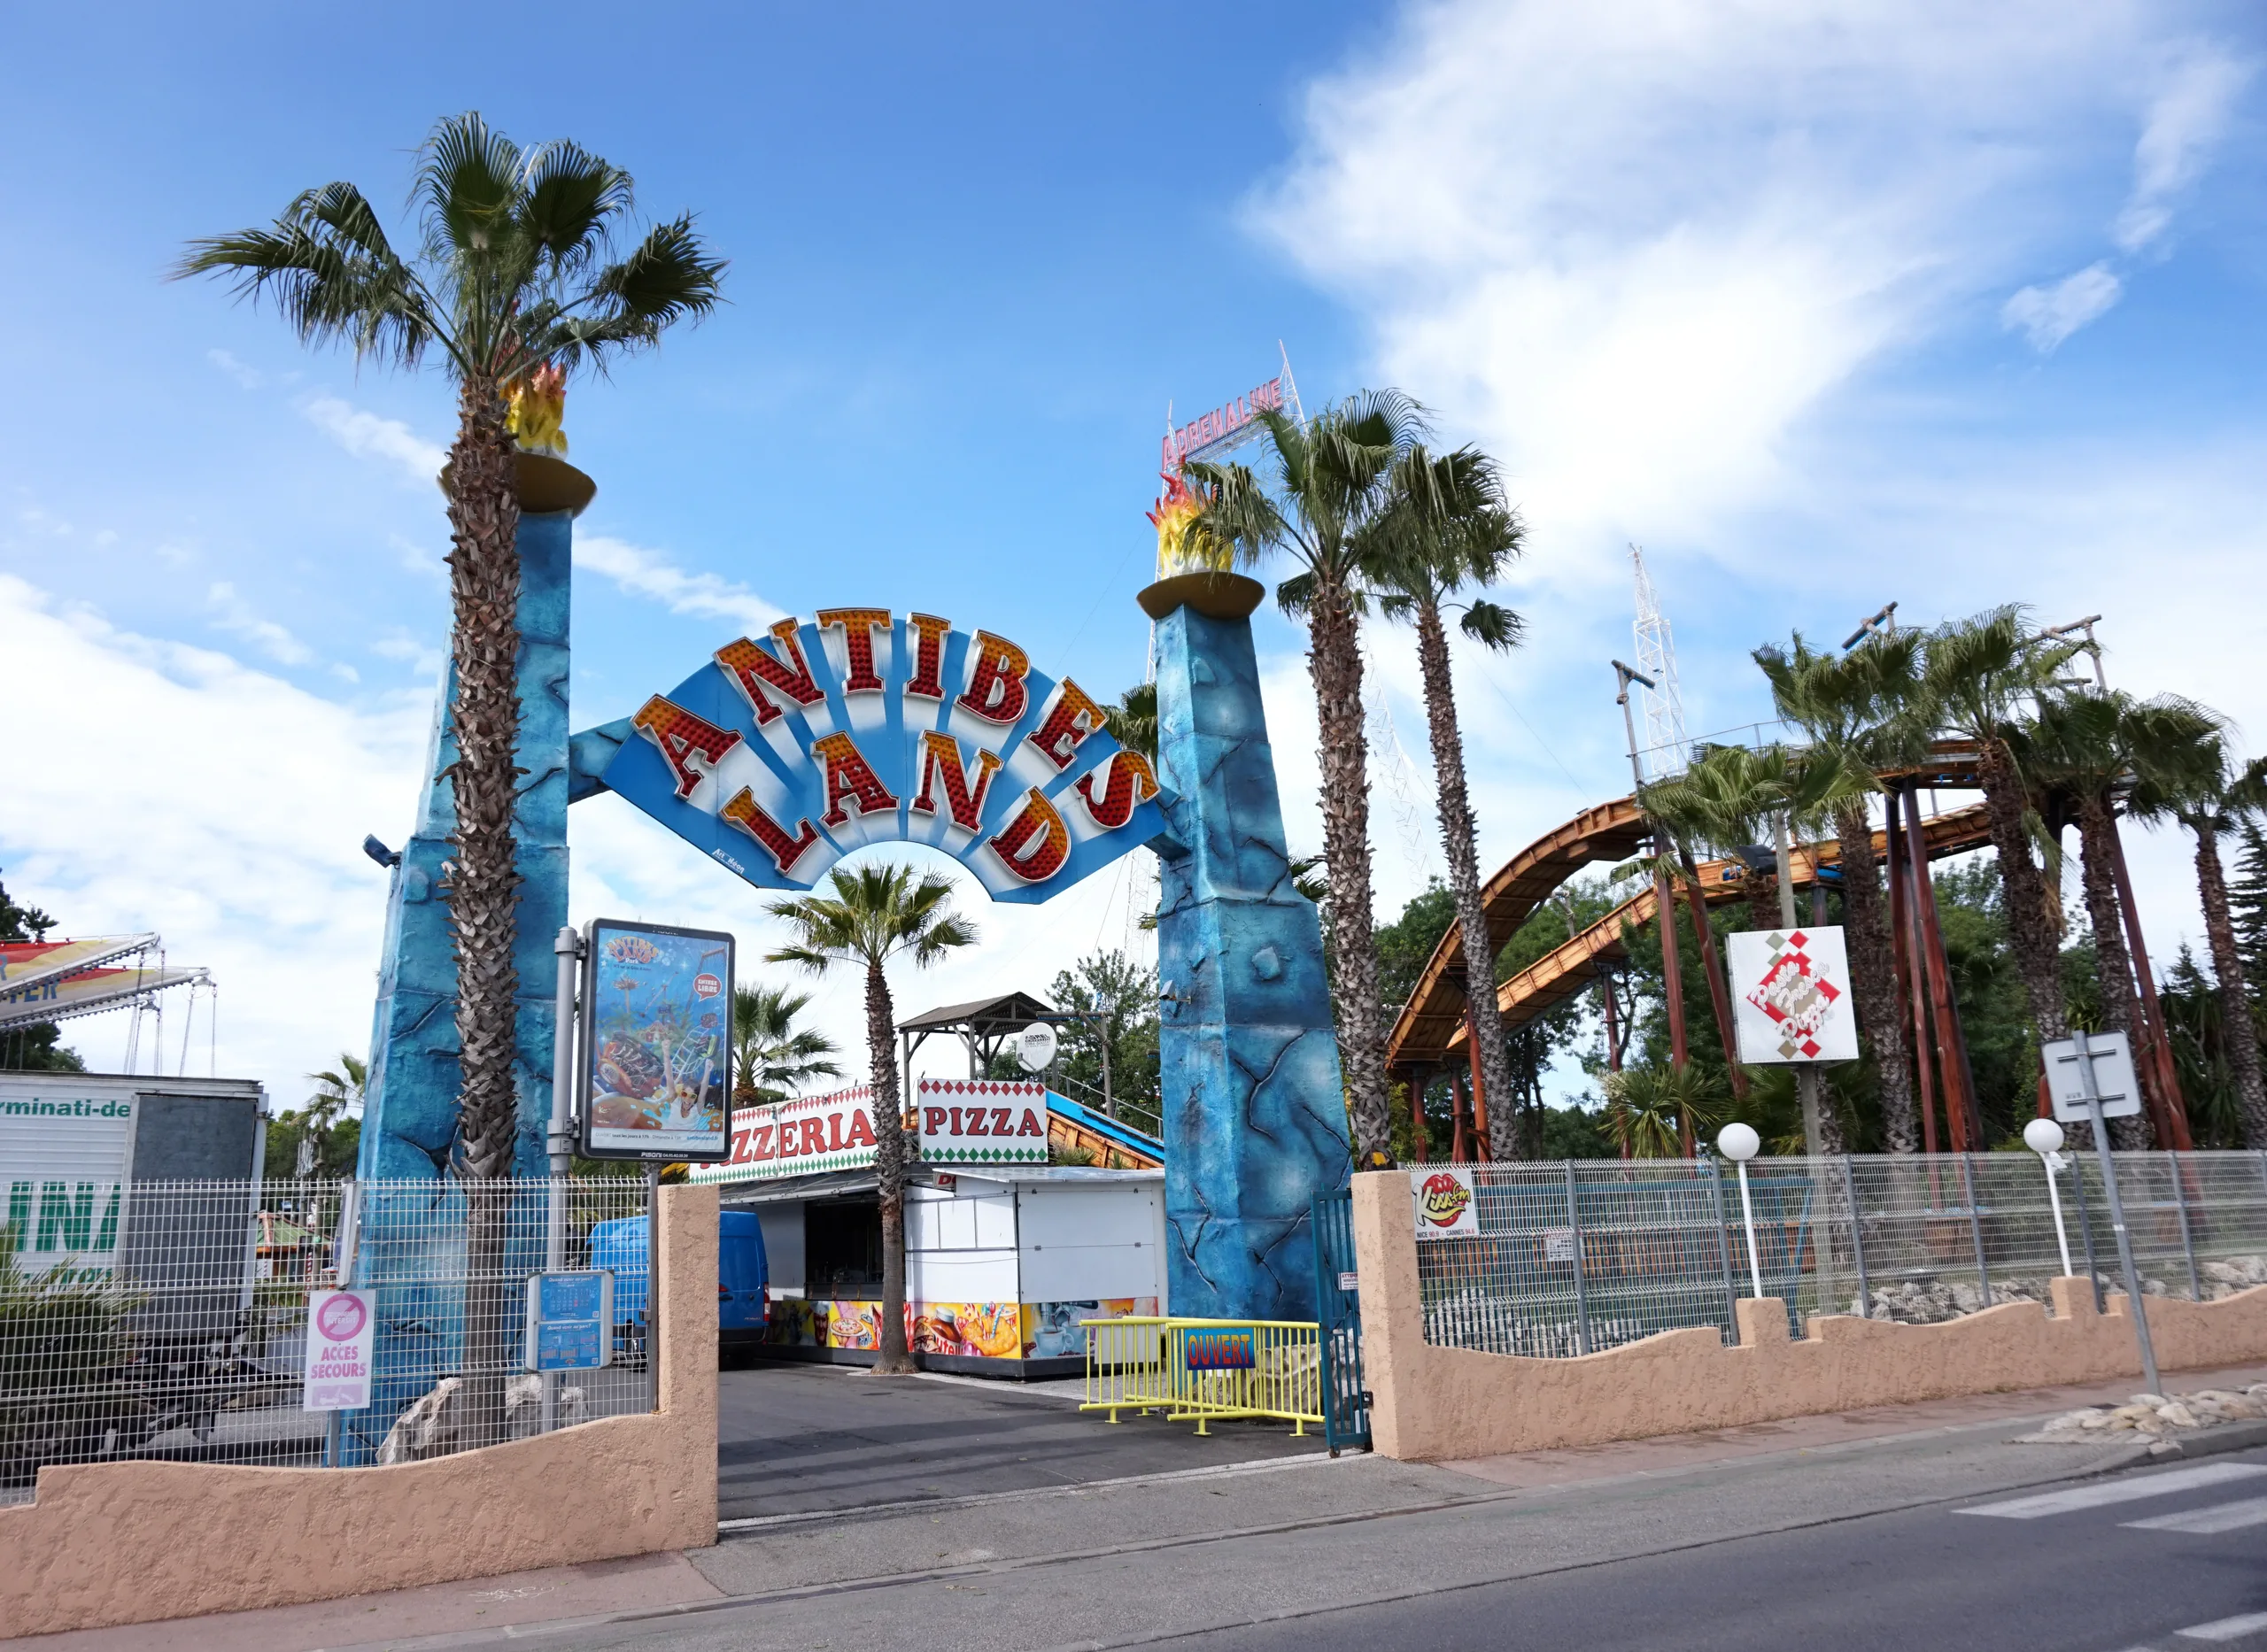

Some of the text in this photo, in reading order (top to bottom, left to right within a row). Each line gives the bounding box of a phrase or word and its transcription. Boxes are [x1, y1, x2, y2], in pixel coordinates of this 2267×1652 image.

[1161, 376, 1283, 470] ADRENALINE
[630, 606, 1162, 830] ANTIBES
[719, 730, 1072, 884] LAND
[1749, 961, 1800, 1011] Pasta
[1776, 994, 1831, 1047] Pizza
[700, 1108, 878, 1170] ZZERIA
[923, 1107, 1044, 1137] PIZZA
[1446, 1228, 1465, 1237] CANNES
[310, 1362, 367, 1379] SECOURS
[321, 1345, 359, 1362] ACCES
[1188, 1334, 1250, 1366] OUVERT
